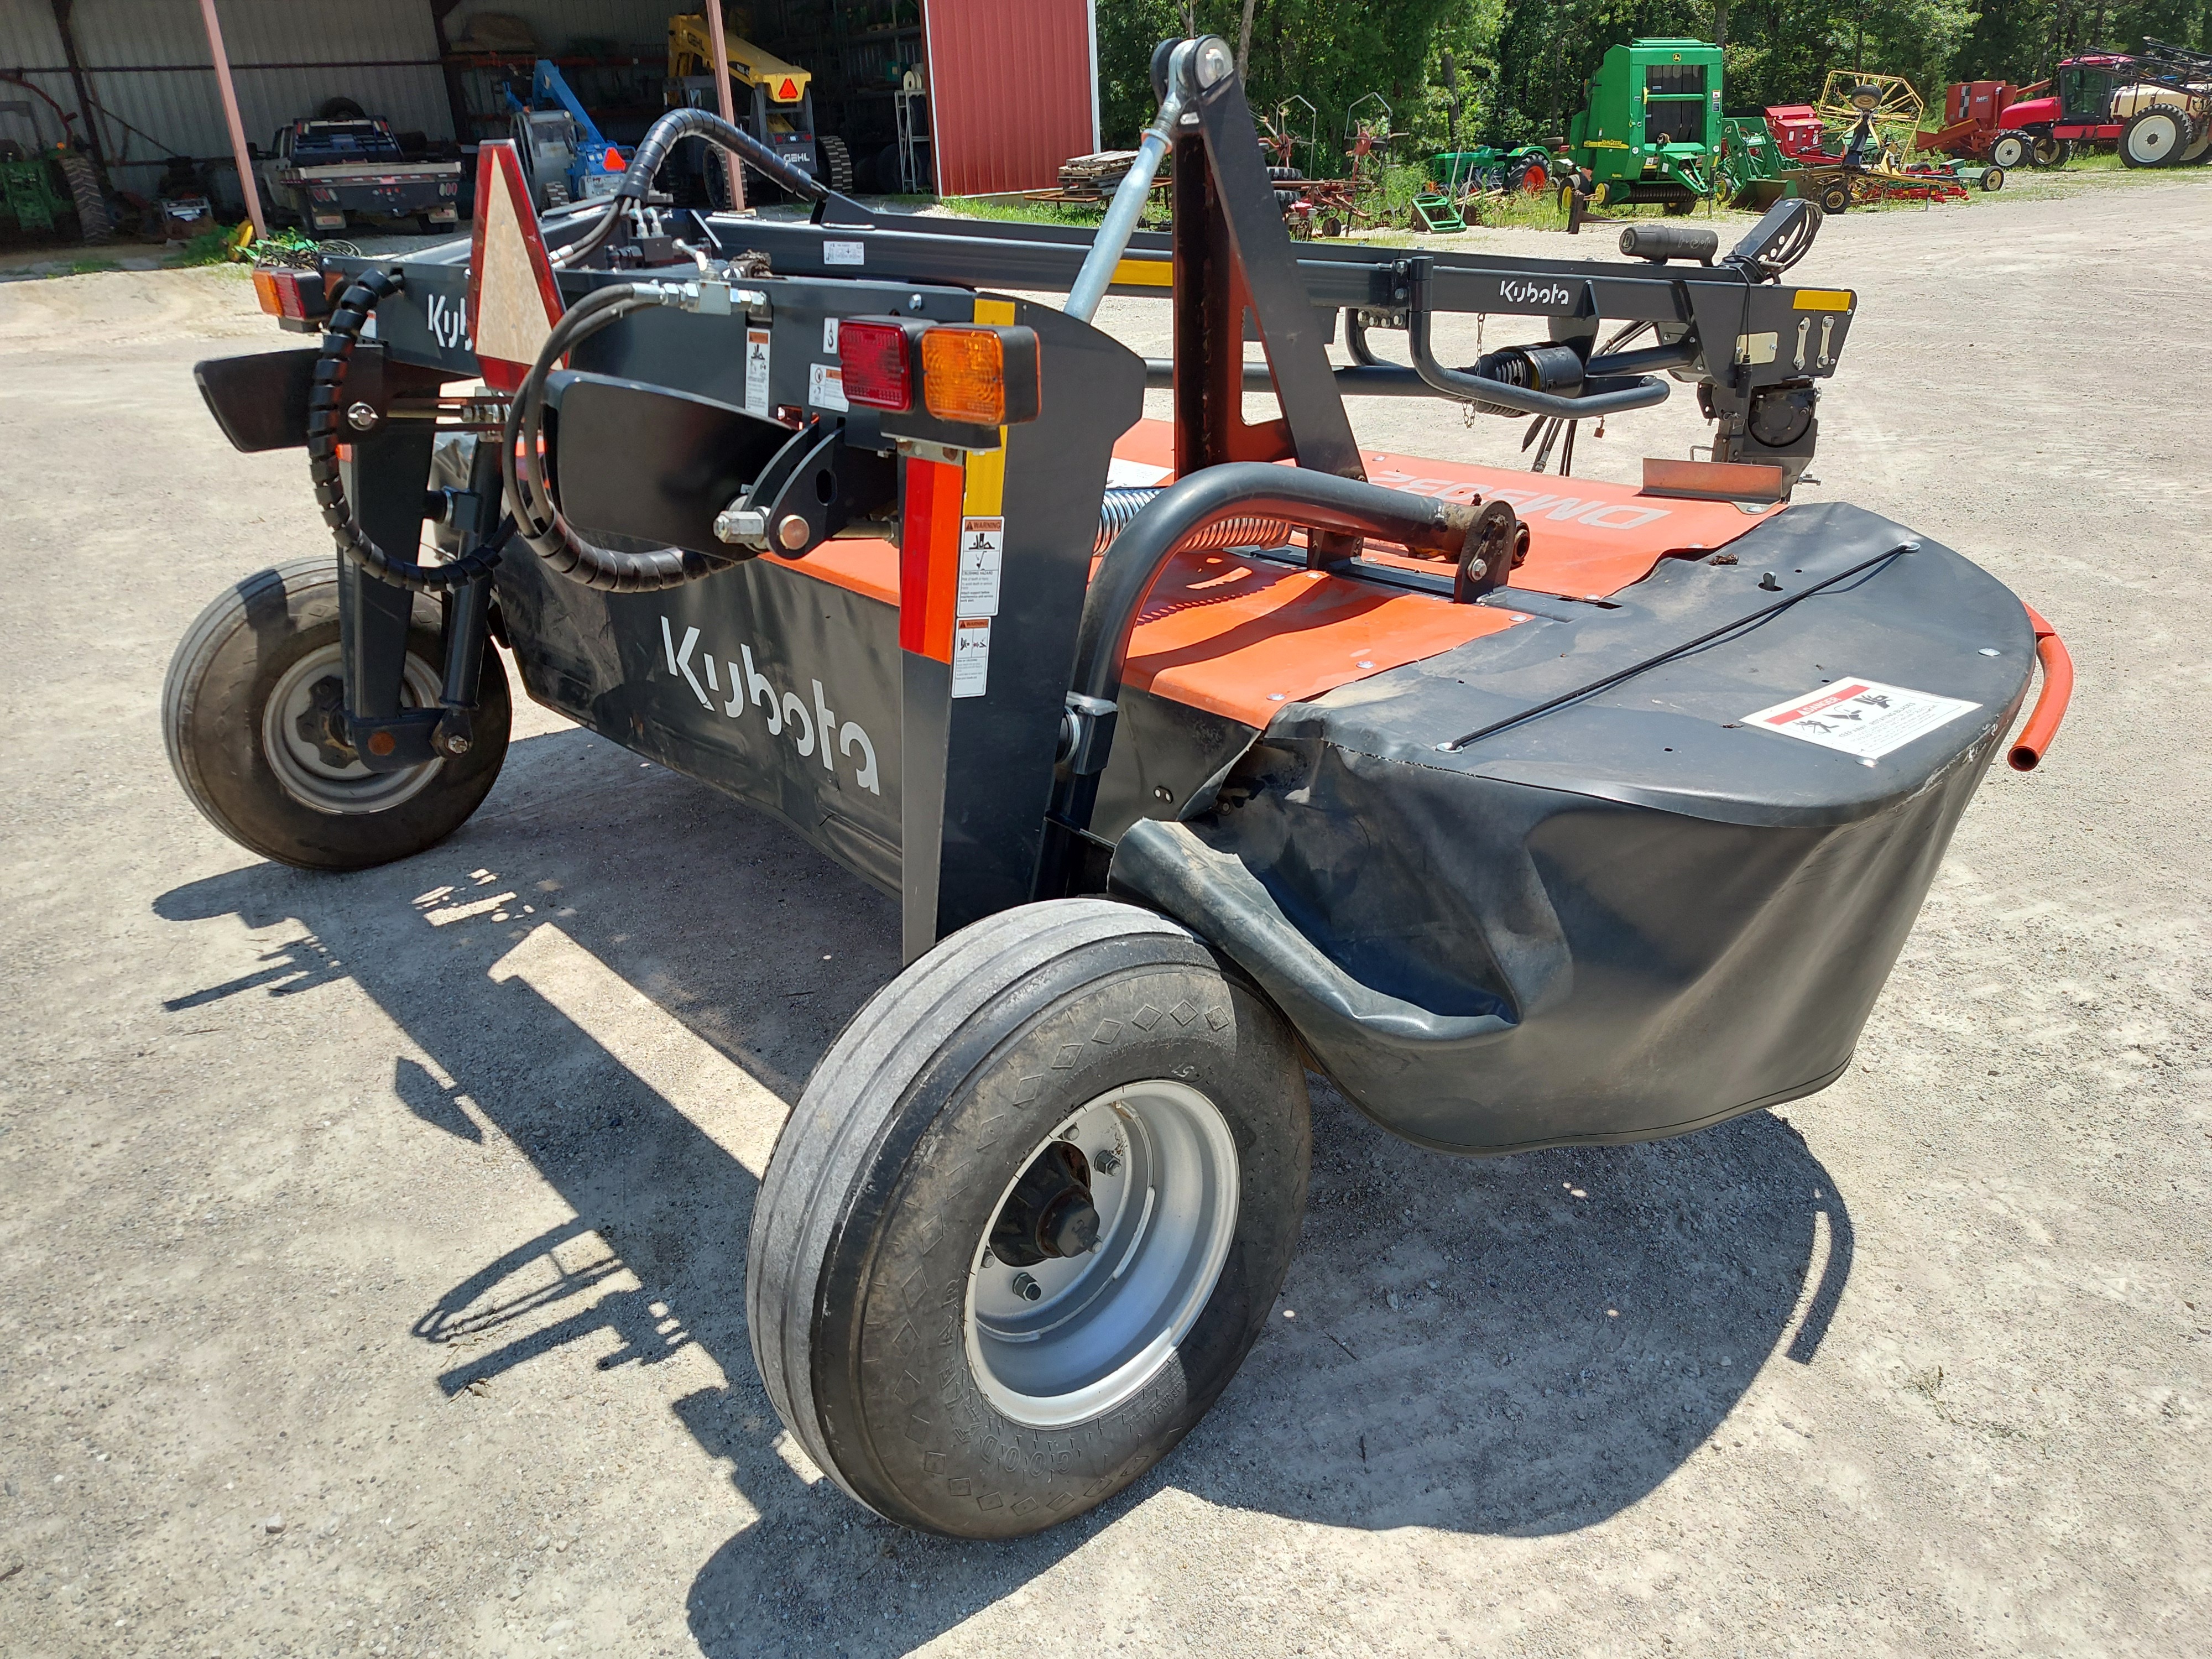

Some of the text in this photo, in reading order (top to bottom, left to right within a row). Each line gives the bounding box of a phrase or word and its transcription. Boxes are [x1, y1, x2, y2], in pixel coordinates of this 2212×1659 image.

[783, 153, 810, 163] GEHL
[1500, 280, 1569, 305] Kubota
[428, 294, 473, 351] Kub
[661, 615, 880, 796] Kubota
[1804, 697, 1842, 713] DANGER
[1869, 711, 1897, 725] ROTATING
[1893, 702, 1916, 713] BLADES
